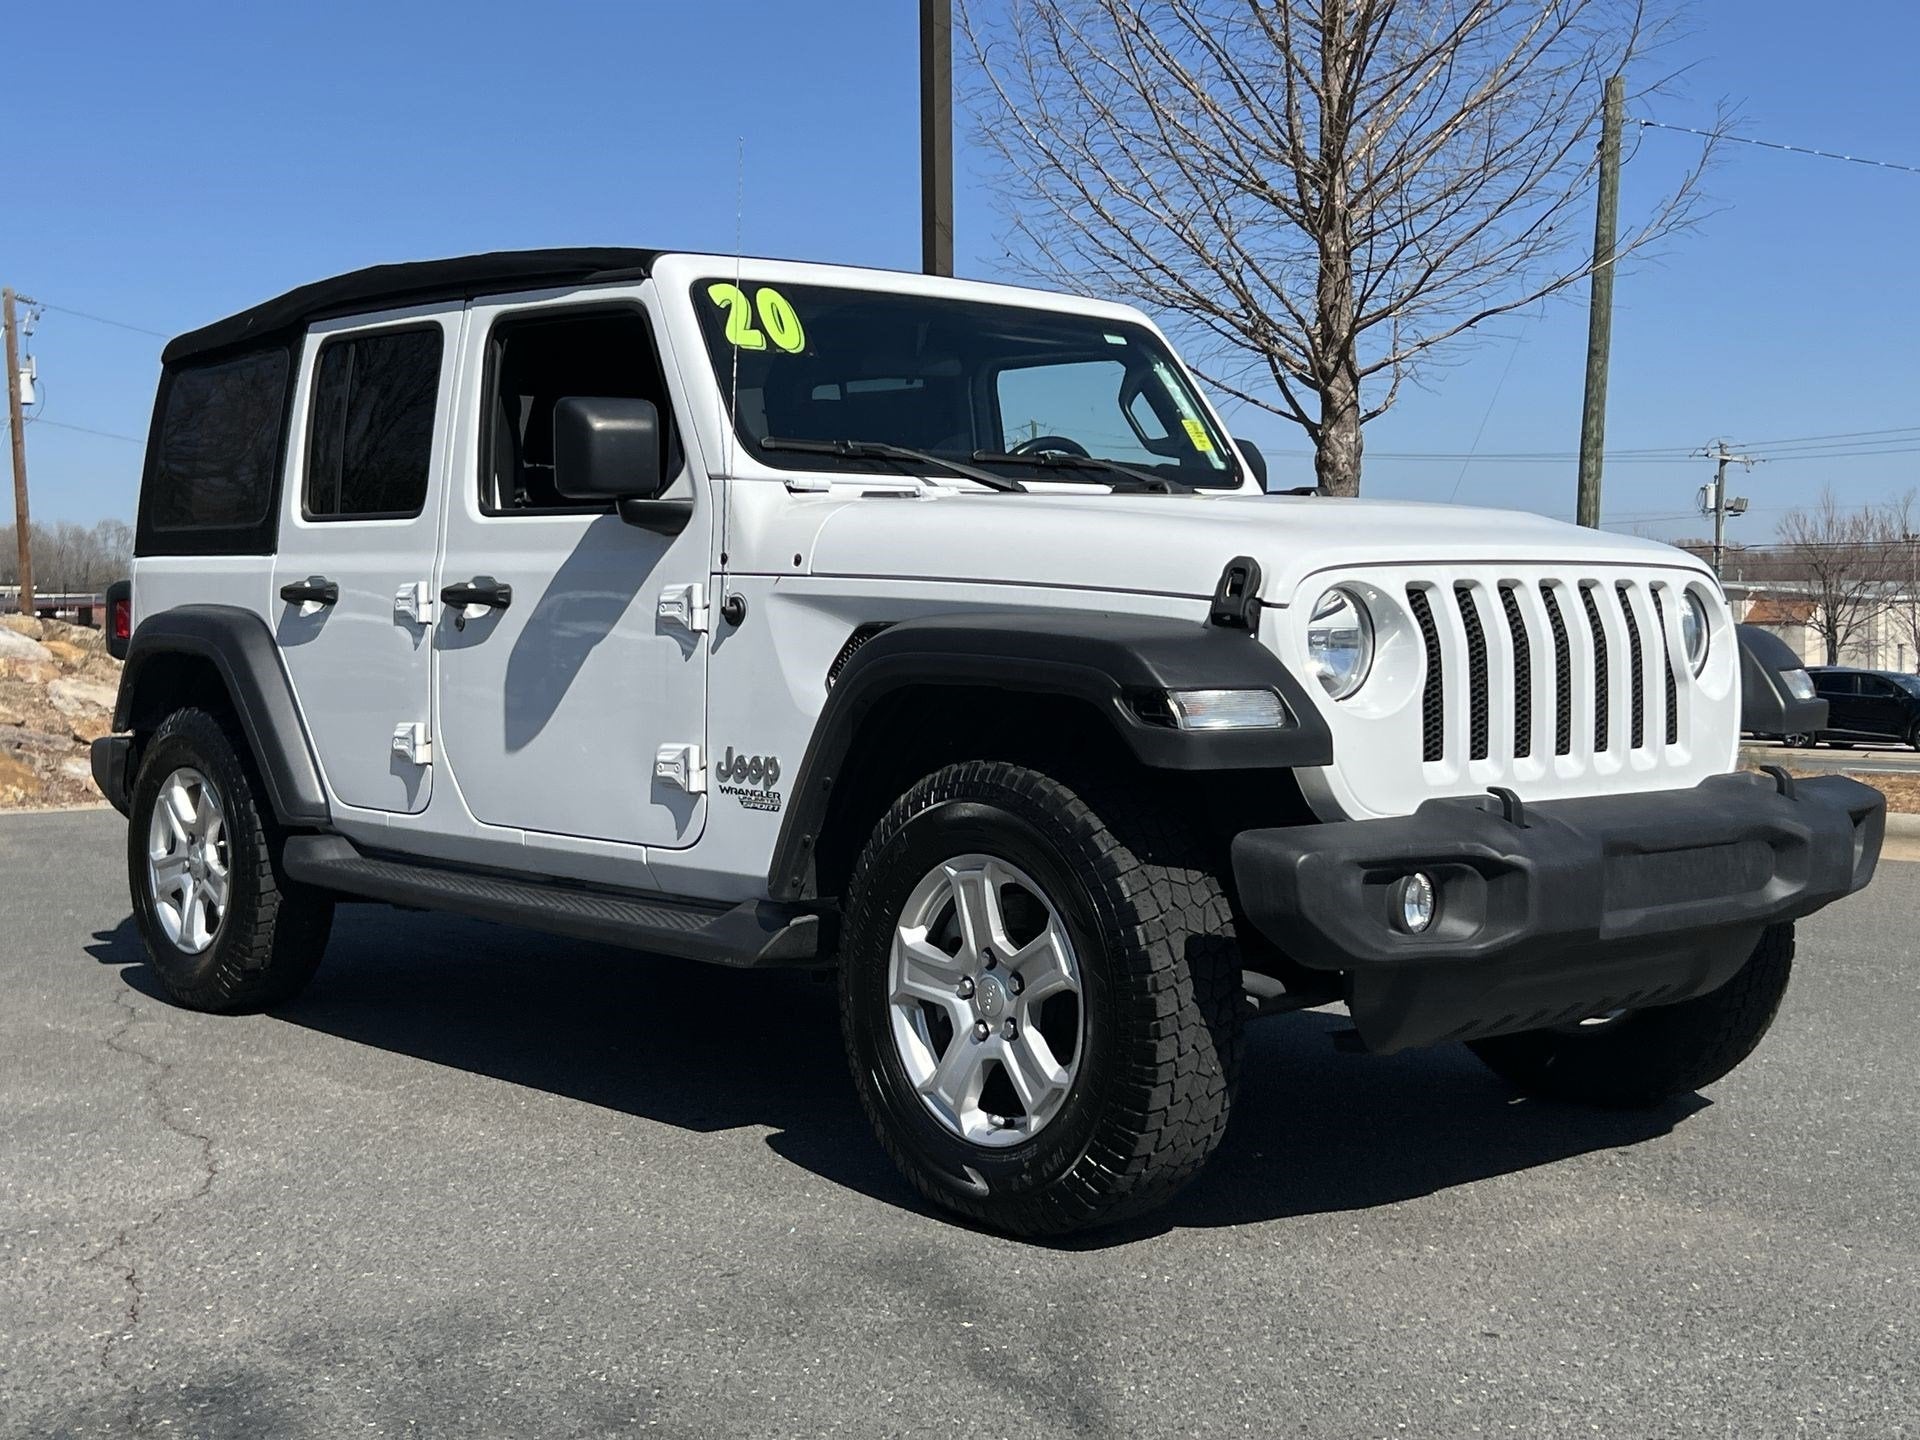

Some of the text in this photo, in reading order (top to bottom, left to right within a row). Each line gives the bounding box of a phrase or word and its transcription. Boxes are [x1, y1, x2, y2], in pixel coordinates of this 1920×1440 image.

[707, 283, 806, 354] 20
[716, 746, 781, 792] Jeep
[719, 785, 781, 801] WRANGLER
